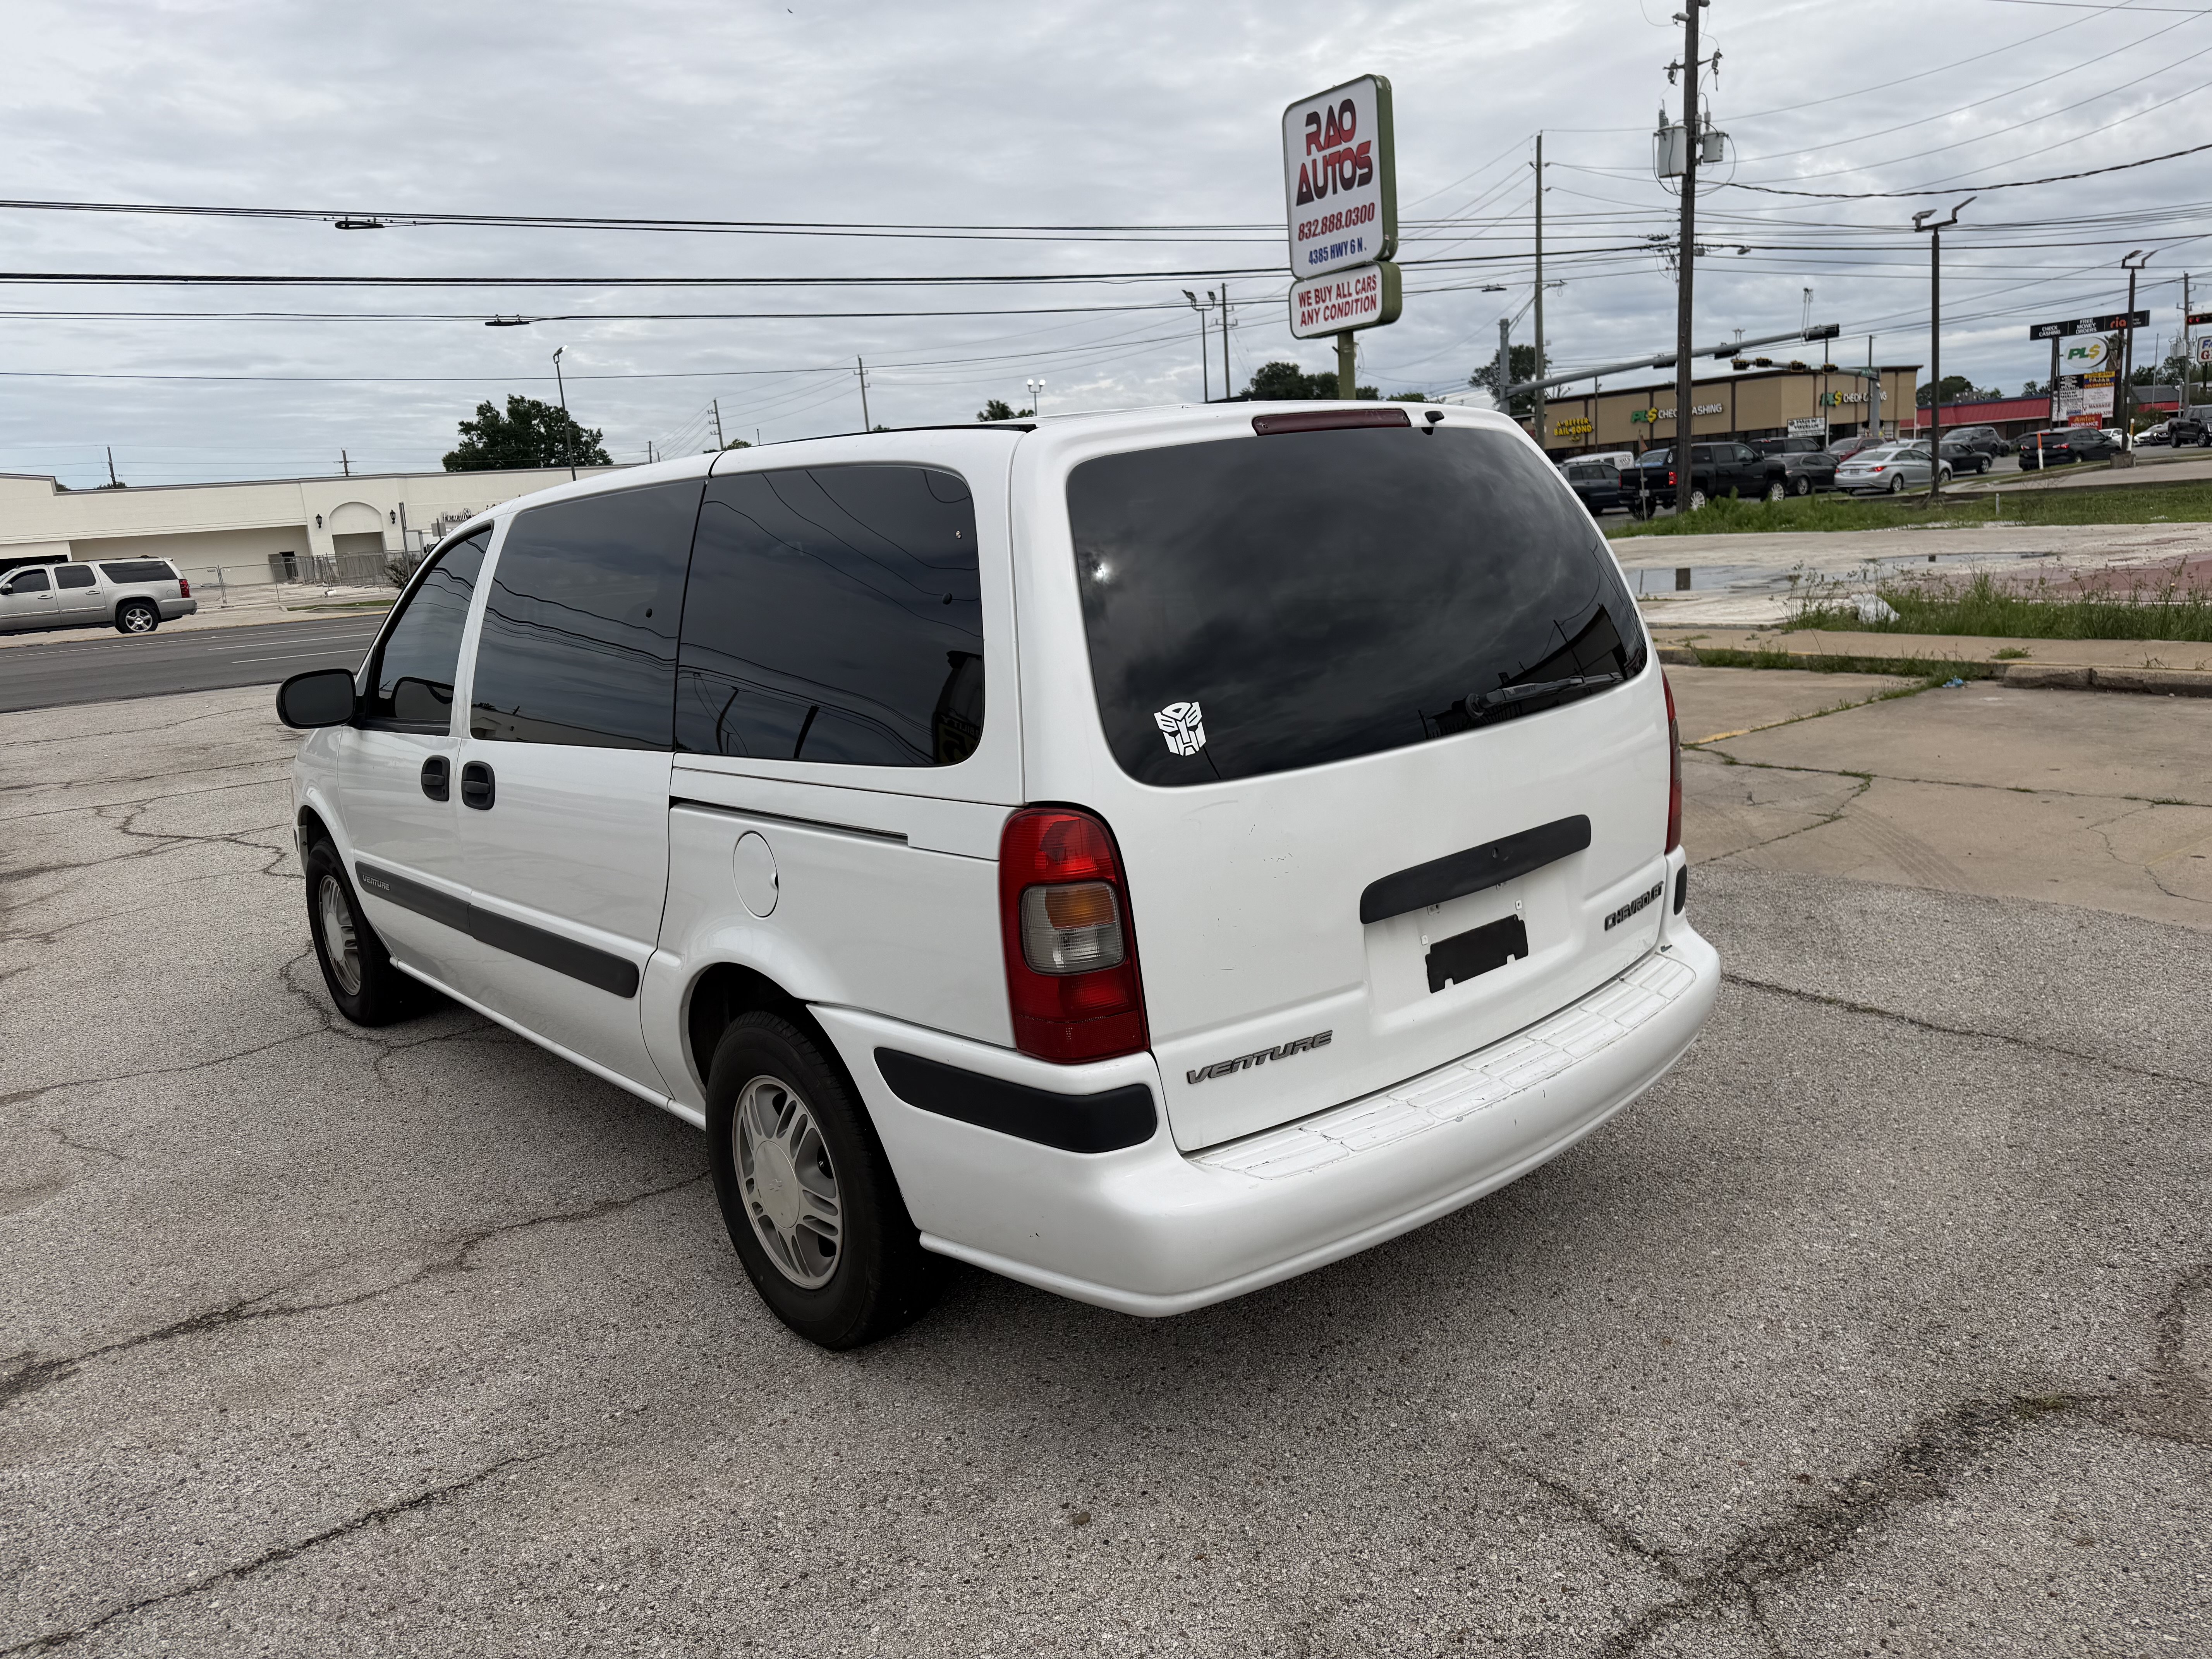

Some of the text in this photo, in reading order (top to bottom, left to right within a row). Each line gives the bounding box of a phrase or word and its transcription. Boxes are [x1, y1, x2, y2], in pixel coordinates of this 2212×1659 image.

[1305, 99, 1356, 156] RAO
[1296, 140, 1373, 206] AUTOS
[1298, 203, 1375, 242] 832.888.0300
[1309, 247, 1328, 265] 4385
[1330, 241, 1348, 259] HWY
[1350, 239, 1355, 254] 6
[1298, 274, 1377, 308] WE BUY ALL CARS
[1300, 294, 1376, 327] ANY CONDITION
[2110, 316, 2126, 328] ria
[1658, 408, 1678, 419] CHEC
[1691, 403, 1723, 415] ASHING
[362, 874, 390, 891] VENTURE
[1604, 881, 1664, 931] CHEVROLET
[1187, 1030, 1333, 1084] VENTURE
